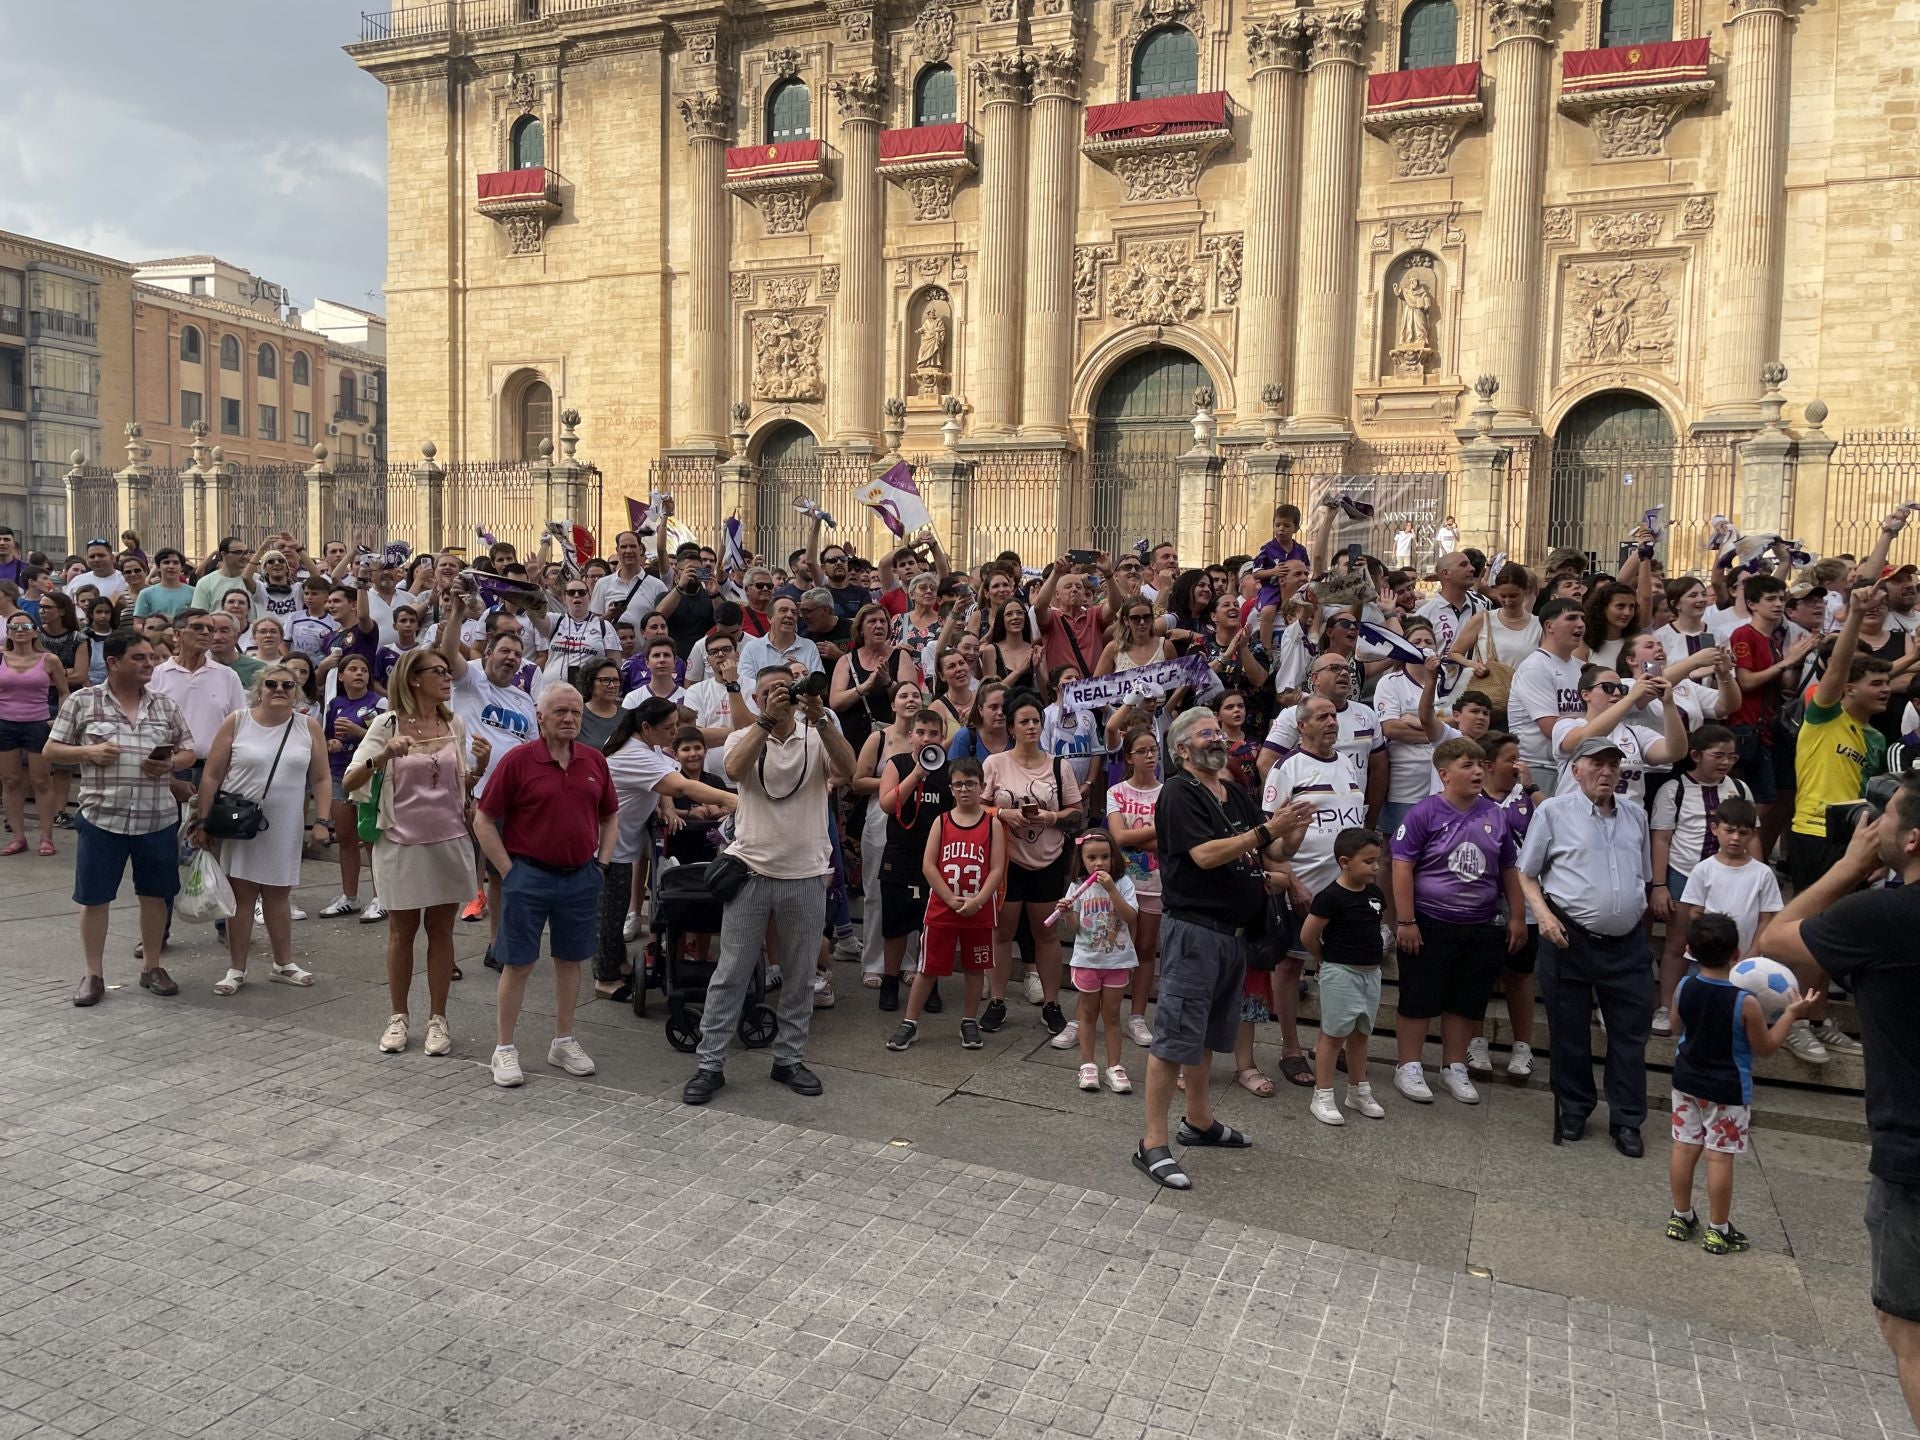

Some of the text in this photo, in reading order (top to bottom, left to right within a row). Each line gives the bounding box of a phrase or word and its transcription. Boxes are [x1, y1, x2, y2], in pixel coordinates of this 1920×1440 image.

[1413, 498, 1438, 509] THE
[1383, 511, 1437, 521] MYSTERY
[1073, 668, 1180, 703] REAL JAN C.F.
[914, 793, 940, 804] ICON
[942, 841, 985, 863] BULLS
[943, 864, 982, 898] 33
[973, 945, 990, 953] BULLS
[974, 952, 990, 964] 33
